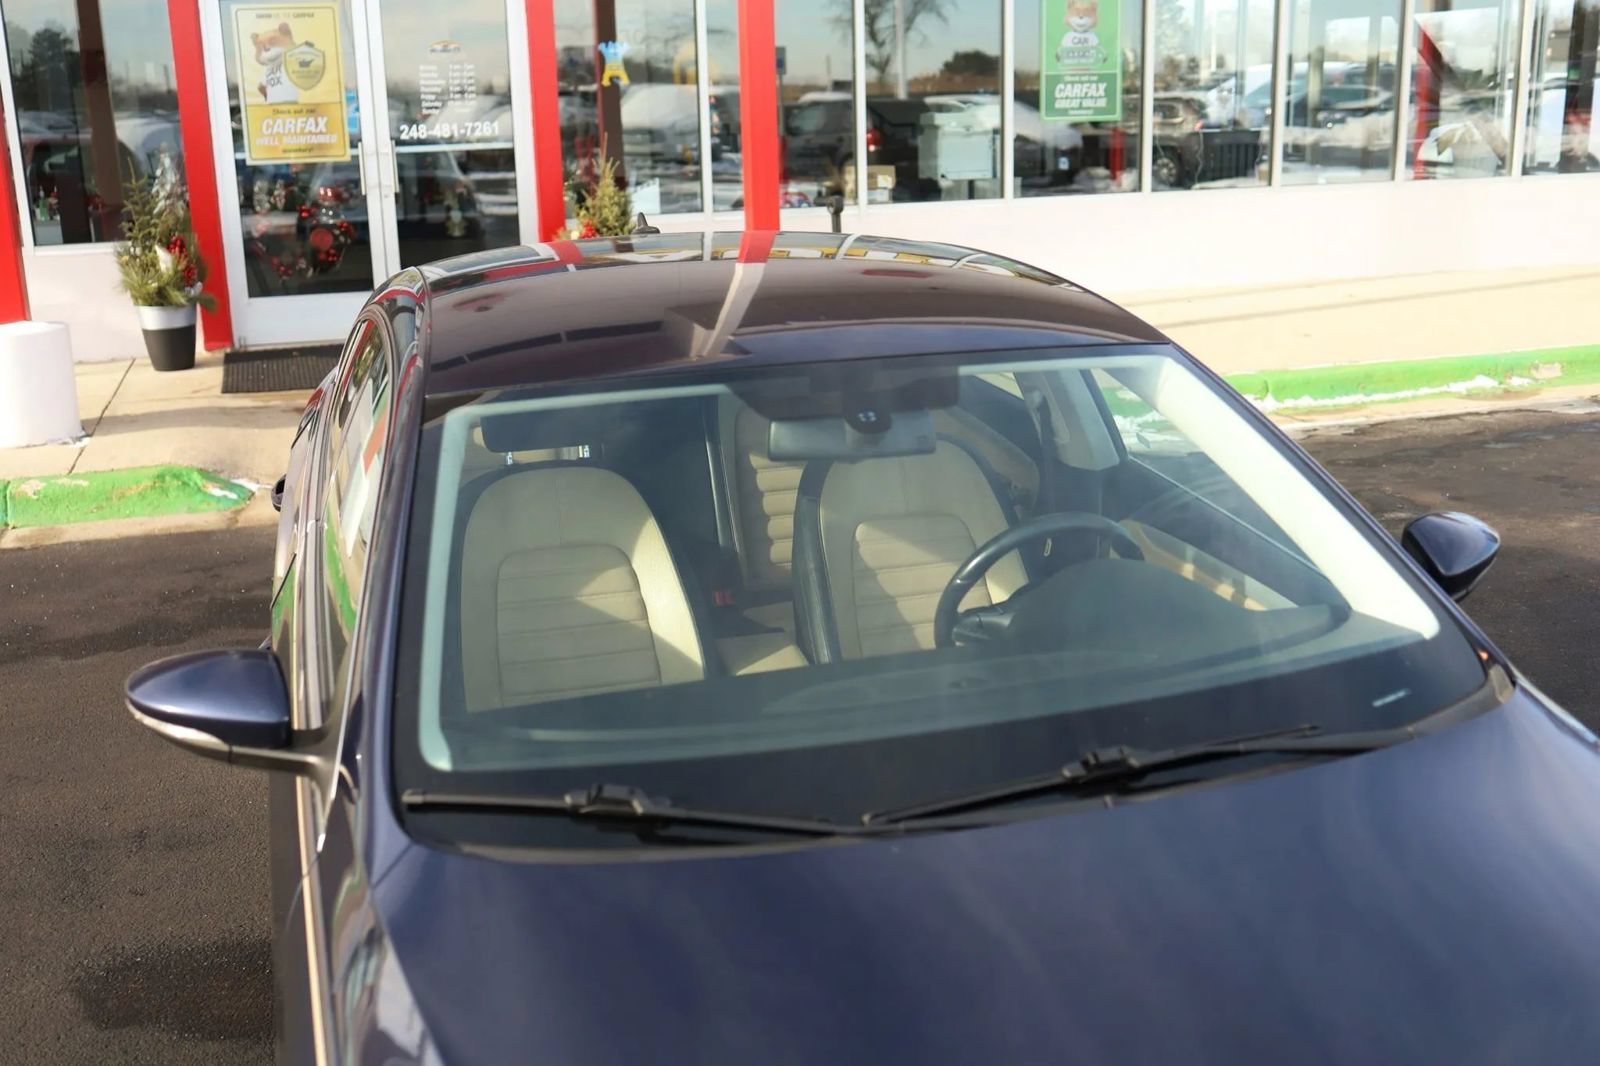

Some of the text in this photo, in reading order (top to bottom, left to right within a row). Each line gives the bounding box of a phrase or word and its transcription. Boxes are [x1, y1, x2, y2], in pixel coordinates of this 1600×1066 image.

[1054, 82, 1107, 98] CARFAX
[262, 116, 328, 134] CARFAX
[399, 121, 500, 140] 248-481-7261
